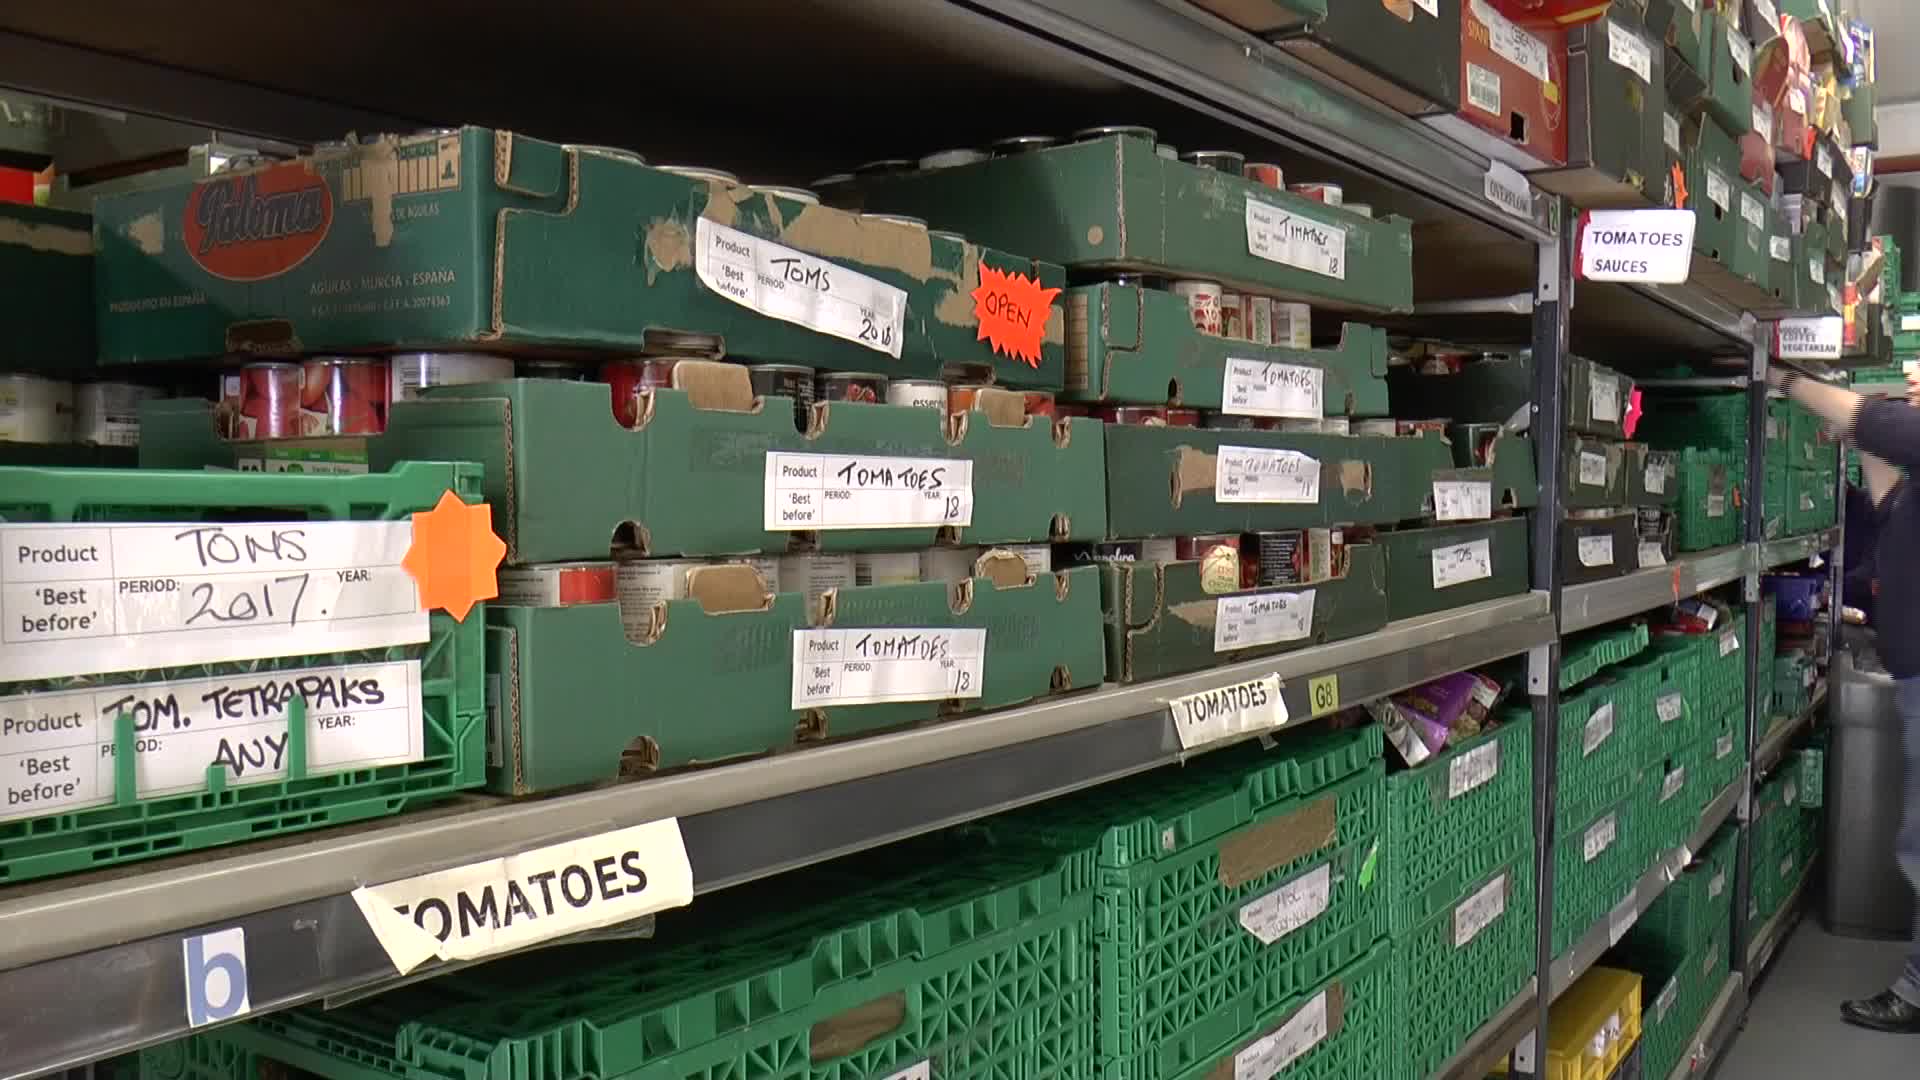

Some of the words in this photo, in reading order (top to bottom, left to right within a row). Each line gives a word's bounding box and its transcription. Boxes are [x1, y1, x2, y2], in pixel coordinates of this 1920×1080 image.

[715, 235, 751, 258] Product
[1592, 231, 1683, 246] TOMATOES
[770, 258, 830, 292] TOMS
[1328, 257, 1339, 274] 18
[1594, 259, 1648, 273] SAUCES
[985, 291, 1032, 328] OPEN
[1783, 344, 1837, 353] VEGETARIAN
[1261, 361, 1311, 388] TOMATOES
[782, 465, 818, 478] Product
[837, 461, 946, 490] TOMATOES
[944, 495, 960, 520] 18
[18, 545, 99, 564] Product
[119, 578, 181, 594] PERIOD:
[337, 570, 371, 583] YEAR:
[1247, 599, 1288, 615] TOMATOES
[808, 640, 839, 652] Product
[855, 633, 949, 662] TOMATOES
[954, 669, 971, 694] 18
[201, 675, 385, 720] TETRAPAKS
[1182, 681, 1267, 725] TOMATOES
[1315, 683, 1333, 709] G8
[3, 711, 83, 736] Product
[318, 715, 356, 730] YEAR:
[101, 739, 163, 758] PEOD:
[211, 731, 289, 777] ANY
[393, 851, 648, 942] OMATOES
